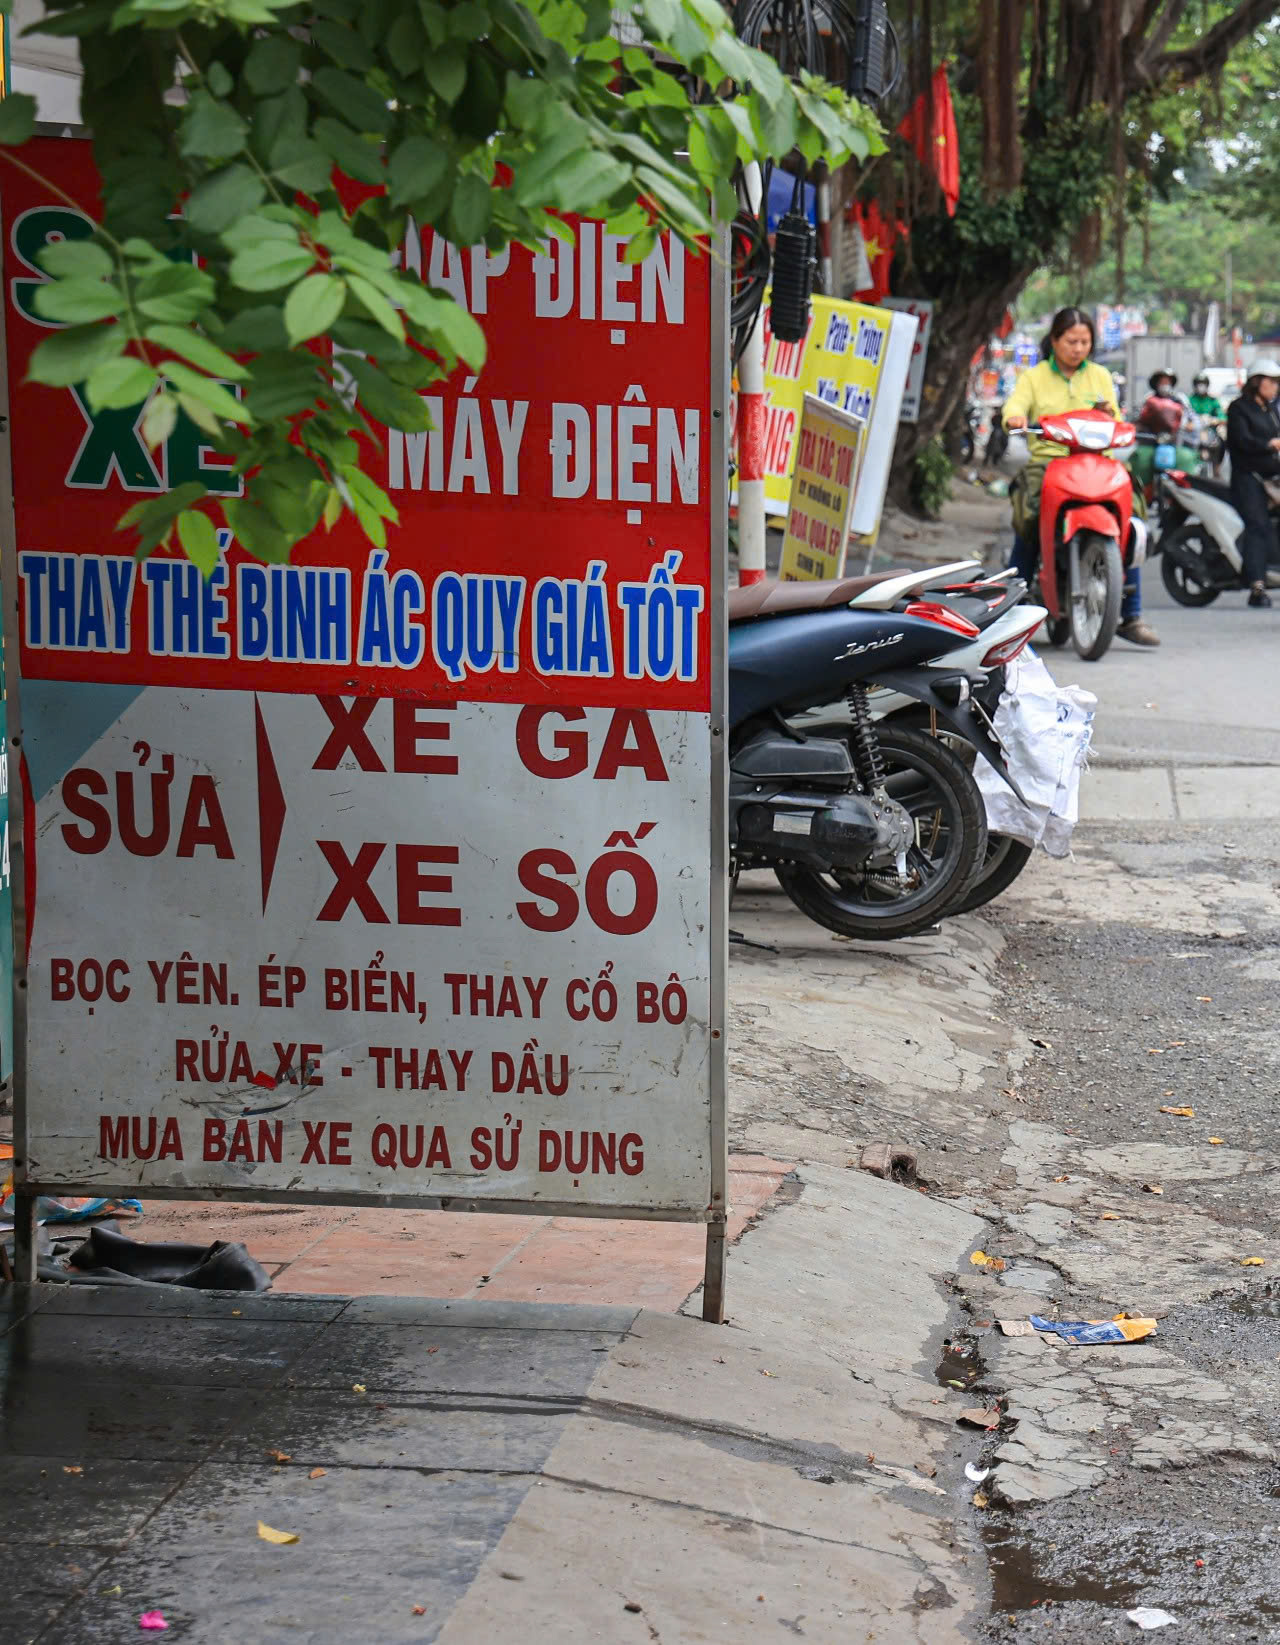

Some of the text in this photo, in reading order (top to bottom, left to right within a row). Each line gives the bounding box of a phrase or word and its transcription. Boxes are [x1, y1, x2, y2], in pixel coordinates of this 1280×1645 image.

[388, 377, 528, 496] MÁY
[549, 384, 700, 525] ĐIỆN
[22, 555, 134, 650] THAY
[145, 530, 229, 655] THẾ
[360, 551, 422, 667] ÁC
[435, 575, 525, 680] QUY
[535, 563, 611, 675] GIÁ
[620, 553, 701, 679] TỐT
[311, 697, 670, 782] XE GA
[61, 740, 236, 860] SỬA
[316, 821, 659, 935] XE SỐ
[51, 949, 688, 1025] BỌC YÊN. ÉP BIỂN, THAY CỔ BÔ
[175, 1024, 569, 1096] RỬA XE - THAY DẦU
[100, 1115, 184, 1161] MUA
[300, 1121, 352, 1166] XE
[371, 1123, 452, 1170] QUA
[470, 1113, 523, 1172] SỬ
[538, 1129, 644, 1188] DỤNG
